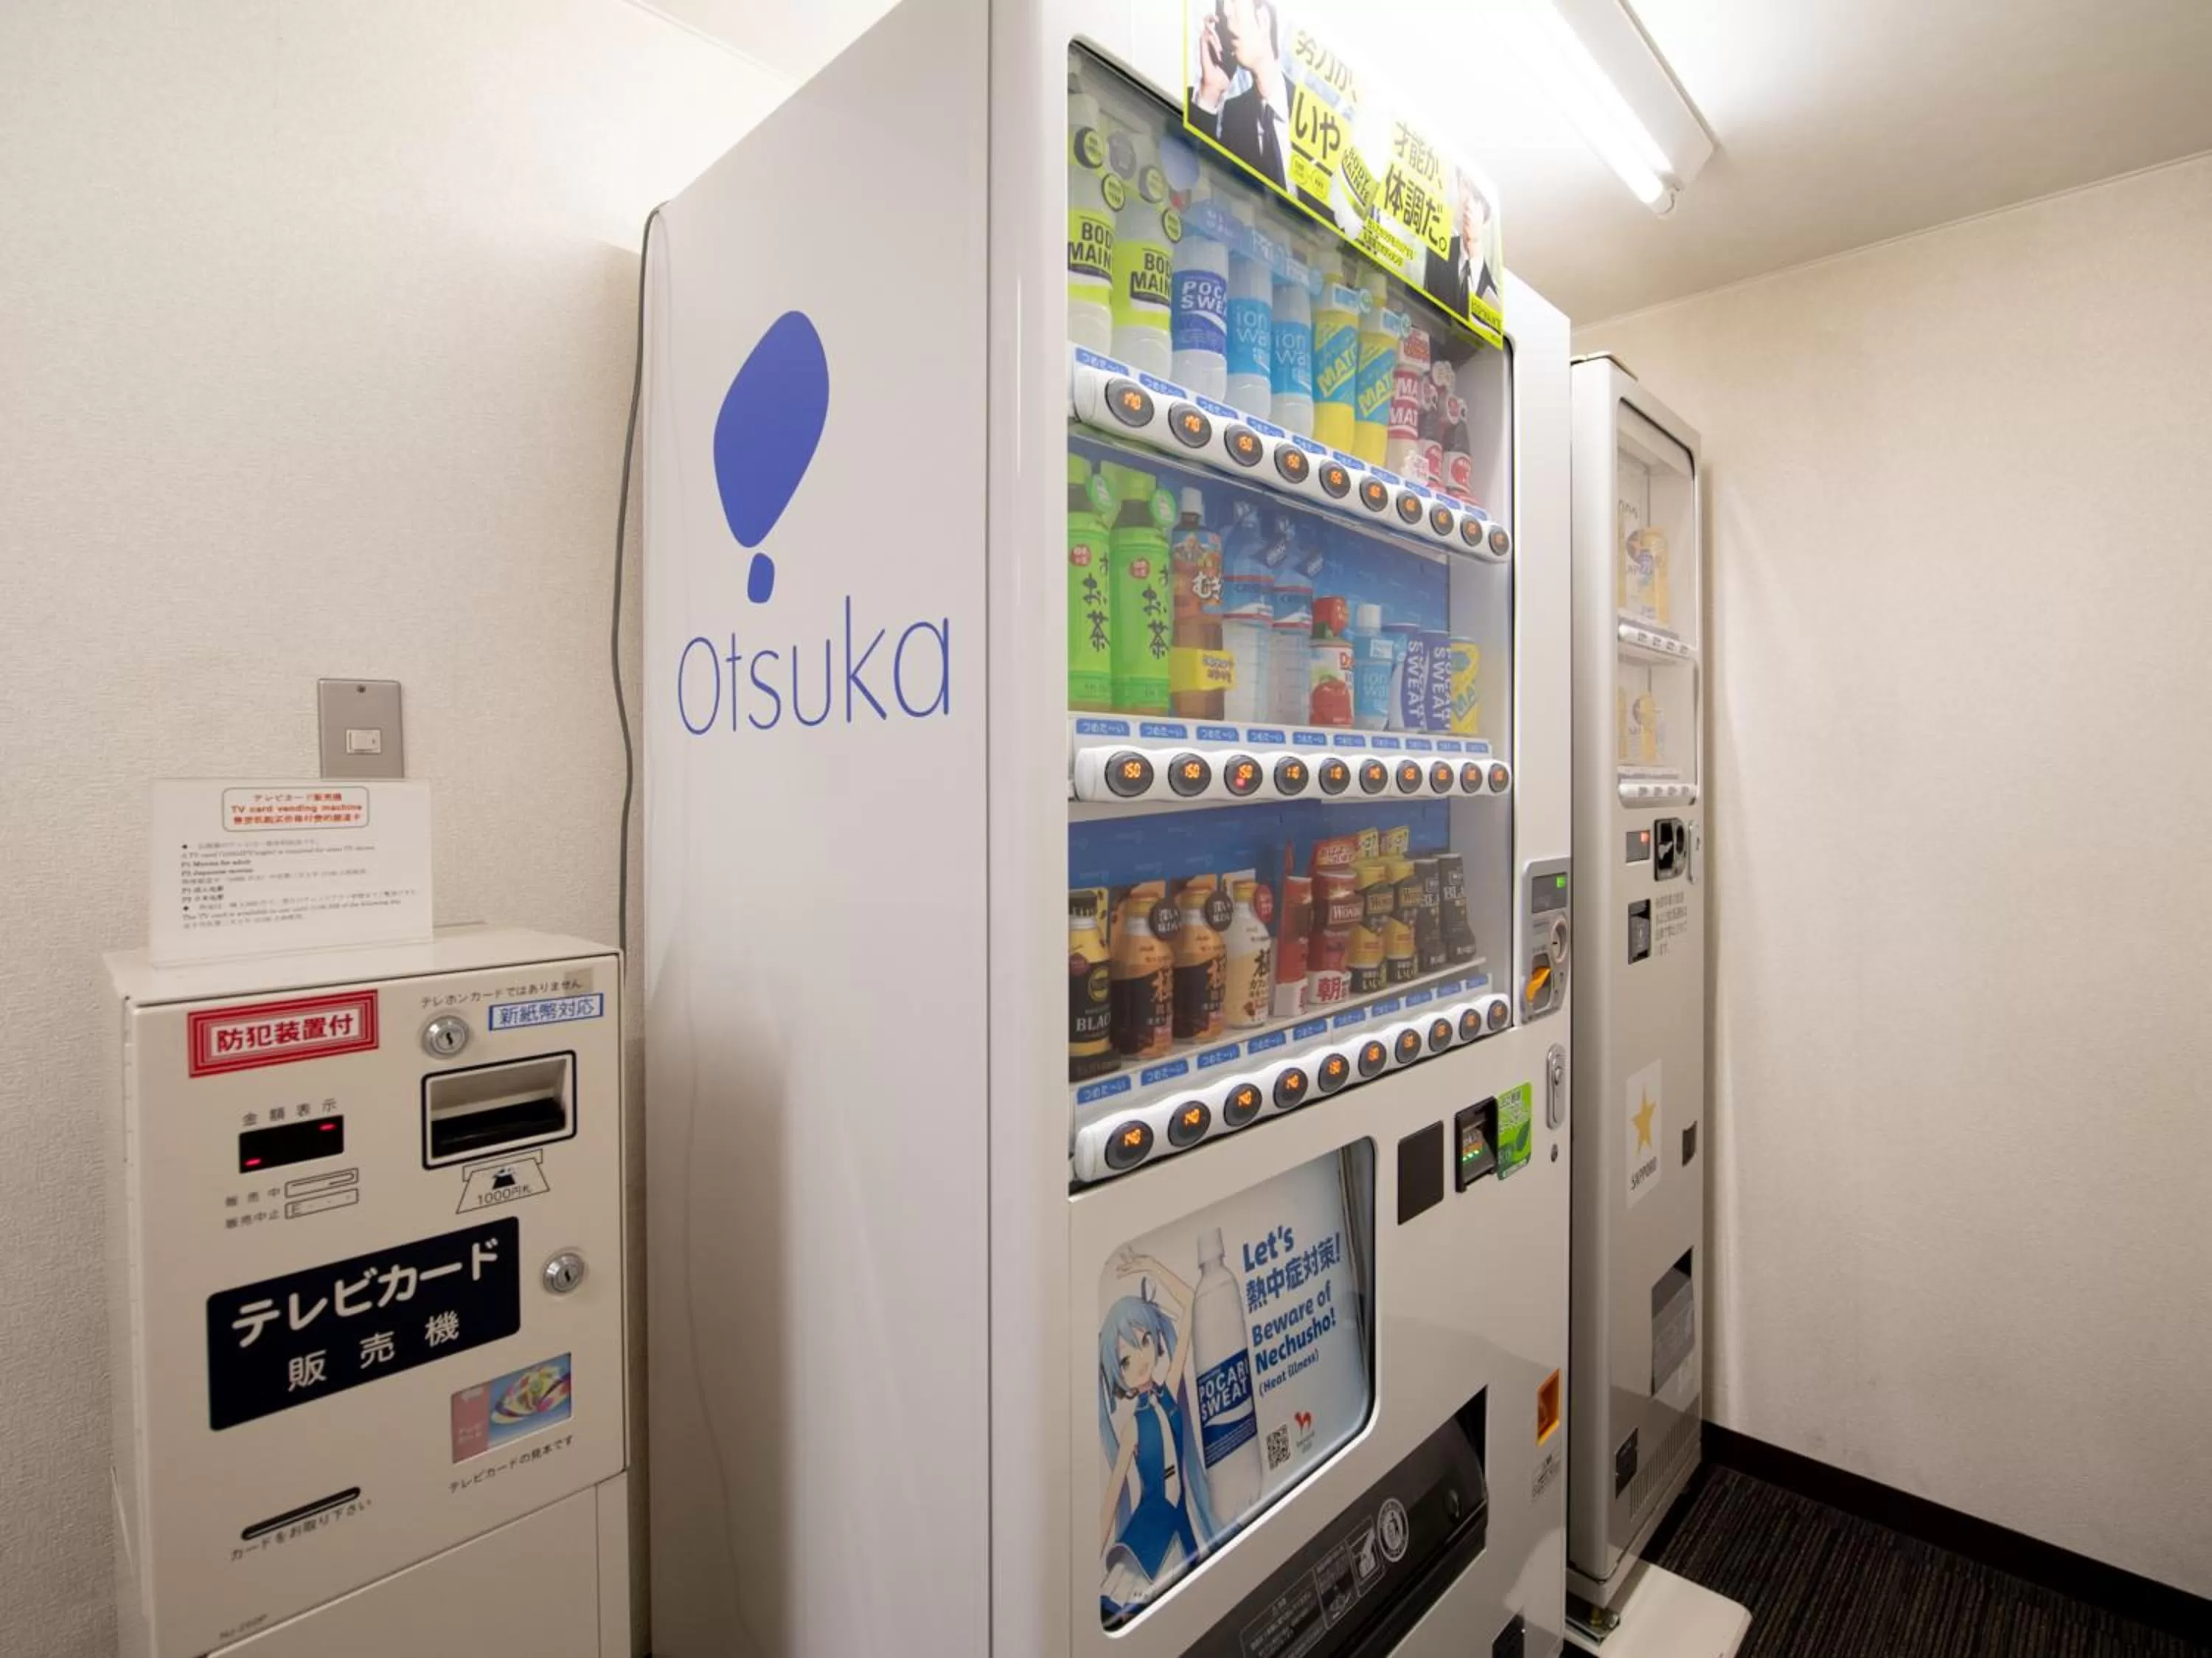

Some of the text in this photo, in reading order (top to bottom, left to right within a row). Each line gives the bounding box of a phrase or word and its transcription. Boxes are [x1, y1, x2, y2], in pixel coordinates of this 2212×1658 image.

[1294, 91, 1340, 160] いや
[1384, 162, 1447, 253] 体調だ。
[678, 594, 950, 735] otsuka
[231, 803, 363, 814] TV card vending machine
[420, 979, 582, 1009] テレホンカードではありません
[499, 998, 595, 1027] 新紙幣対応
[217, 1013, 353, 1052] 防犯装置付
[1242, 1225, 1295, 1273] Let's
[232, 1238, 498, 1348] テレビカード
[1252, 1279, 1332, 1347] Beware of
[1255, 1307, 1337, 1376] Nechusho!
[1199, 1357, 1249, 1403] POCARI
[1200, 1376, 1248, 1422] SWEAT
[1259, 1371, 1287, 1398] (Heat
